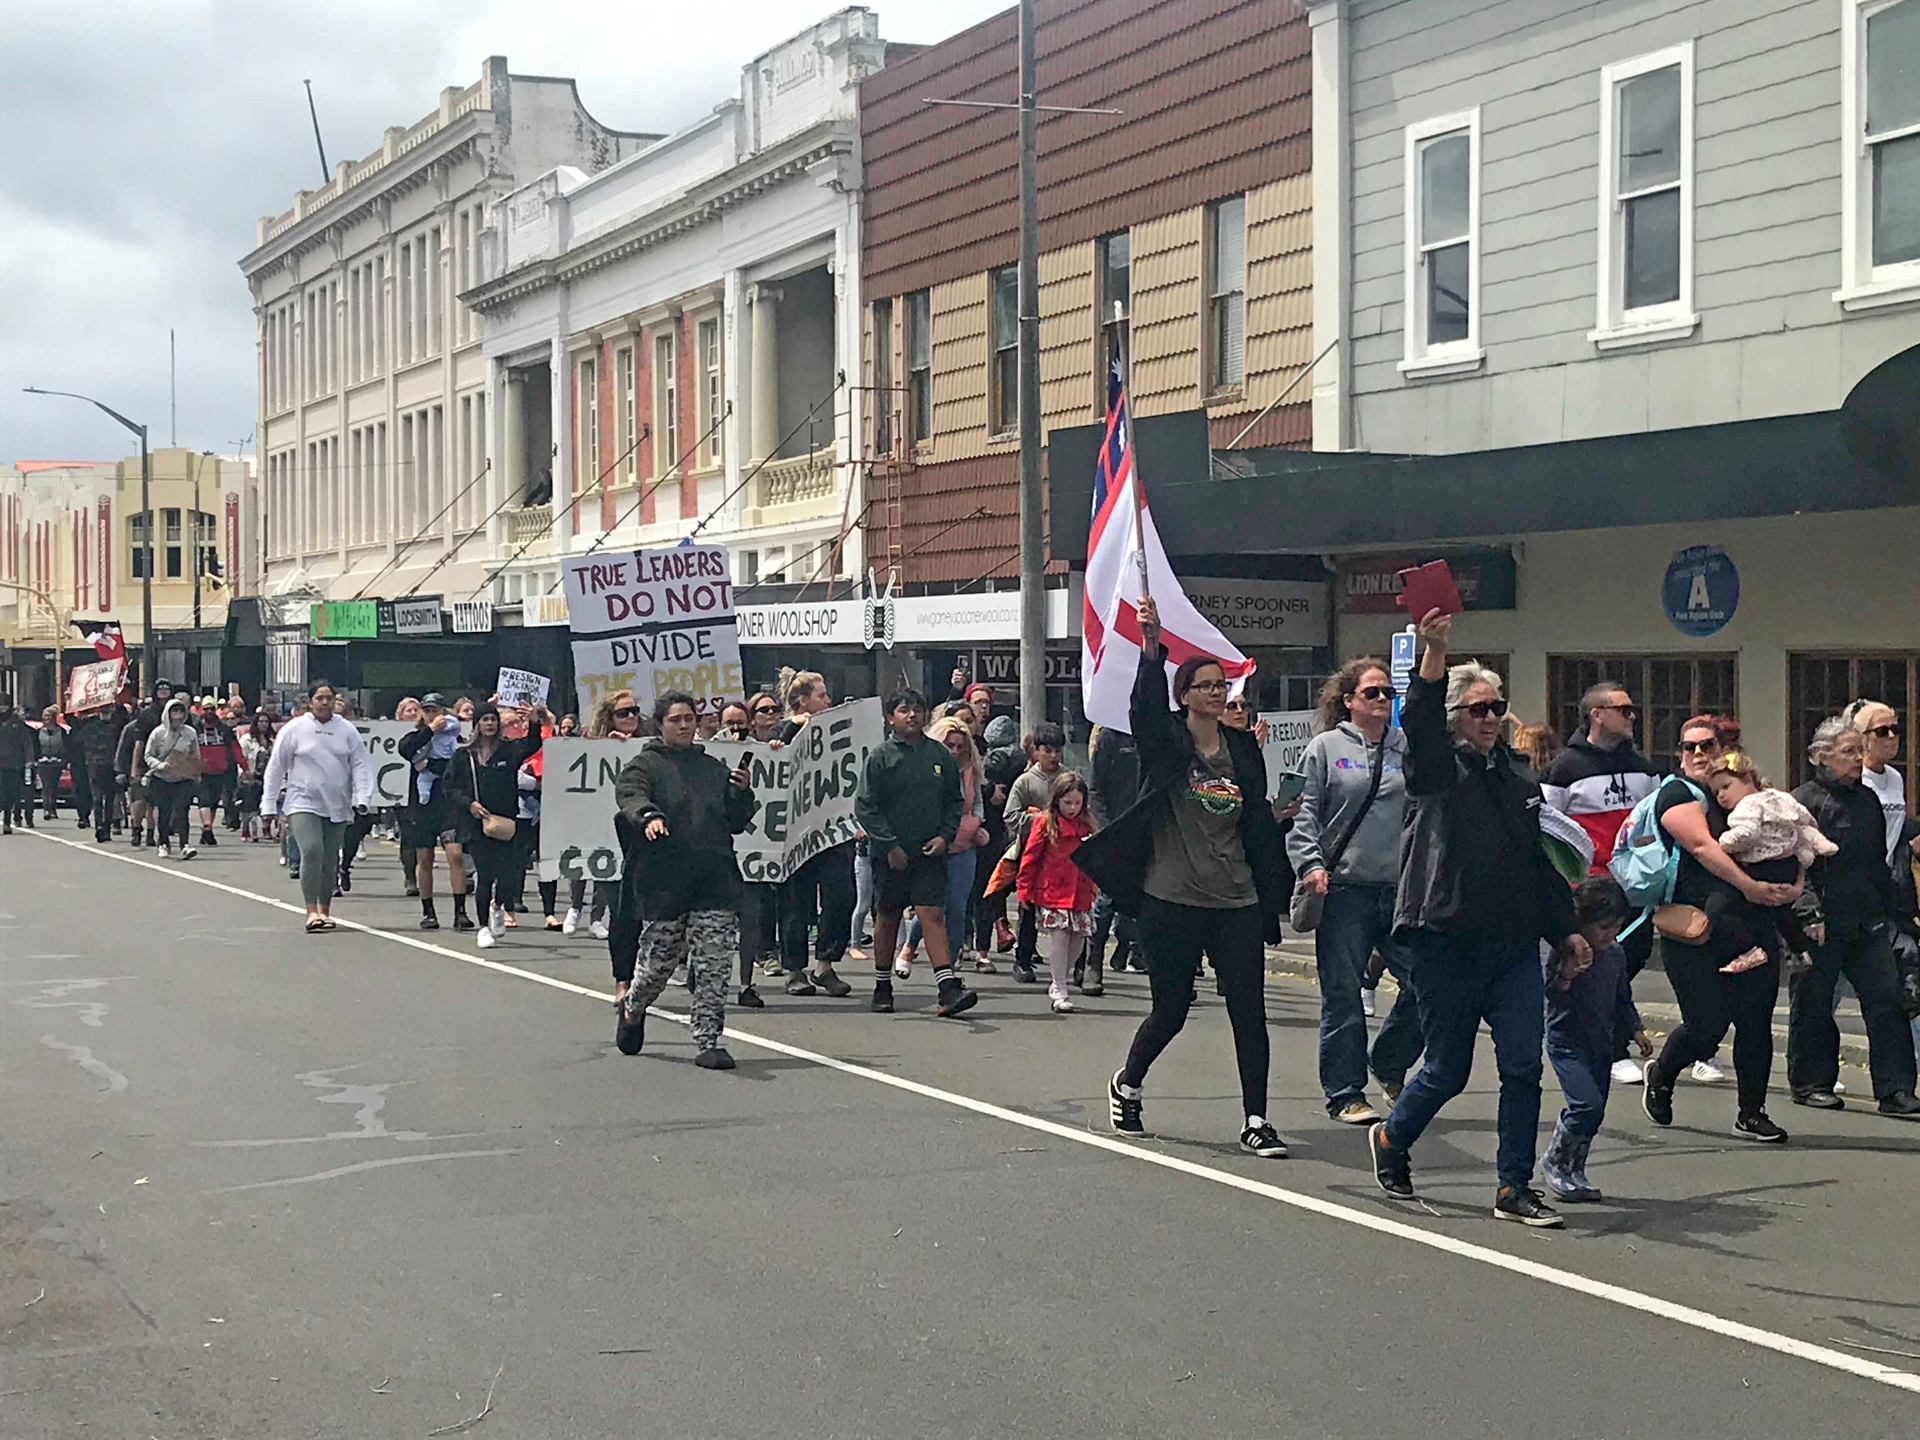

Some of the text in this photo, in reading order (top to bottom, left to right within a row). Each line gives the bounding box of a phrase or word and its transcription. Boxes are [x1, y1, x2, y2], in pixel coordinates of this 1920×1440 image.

[571, 551, 724, 596] TRUE LEADERS
[604, 581, 732, 622] DO NOT
[1235, 596, 1310, 613] SPOONER
[398, 607, 438, 628] LOCKSMITH
[453, 602, 489, 631] TATTOOS
[768, 609, 838, 638] WOOLSHOP
[611, 630, 716, 667] DIVIDE
[1399, 638, 1408, 655] P
[501, 670, 541, 686] #RESIGN
[504, 680, 540, 696] JACINDA
[580, 661, 743, 703] THE PEOPLE
[1266, 721, 1314, 745] FREEDOM
[1283, 744, 1307, 768] OVE
